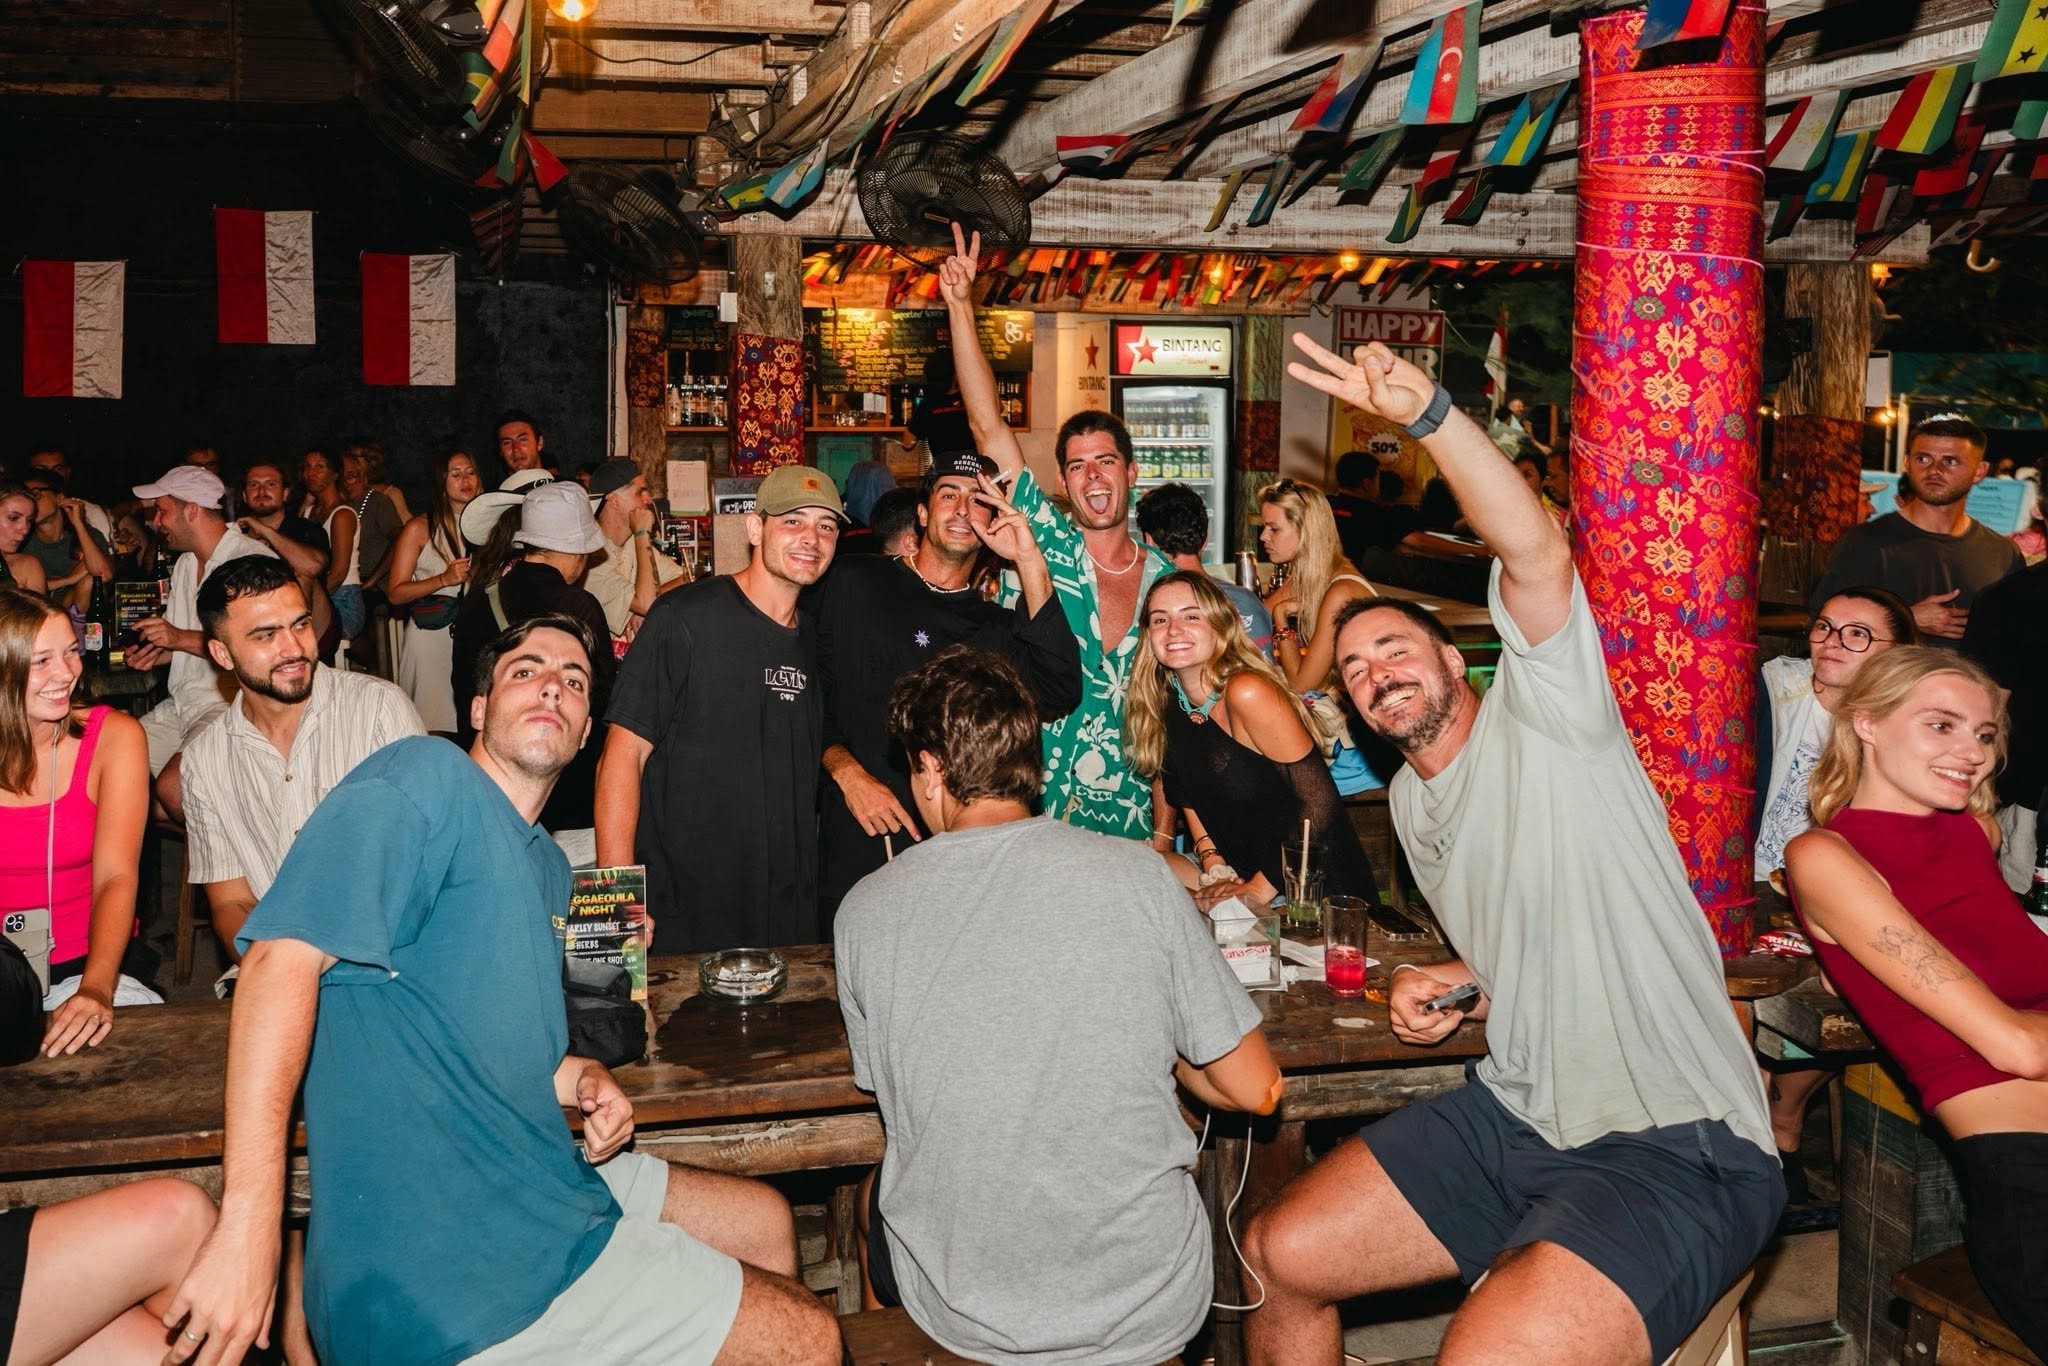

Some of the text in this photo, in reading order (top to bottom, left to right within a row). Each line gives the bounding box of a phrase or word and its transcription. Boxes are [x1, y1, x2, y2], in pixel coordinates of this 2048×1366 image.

[1005, 321, 1024, 343] 85
[1343, 311, 1440, 342] HAPPY
[1162, 339, 1222, 352] BINTANG
[1078, 376, 1105, 391] BINTANG
[1371, 441, 1399, 454] 50%
[953, 460, 983, 470] GENERAL
[955, 465, 980, 474] SUPPLY
[571, 892, 636, 905] GGAEQUILA
[580, 903, 617, 916] NIGHT
[593, 921, 620, 933] SUNSET
[576, 940, 599, 950] HERBS
